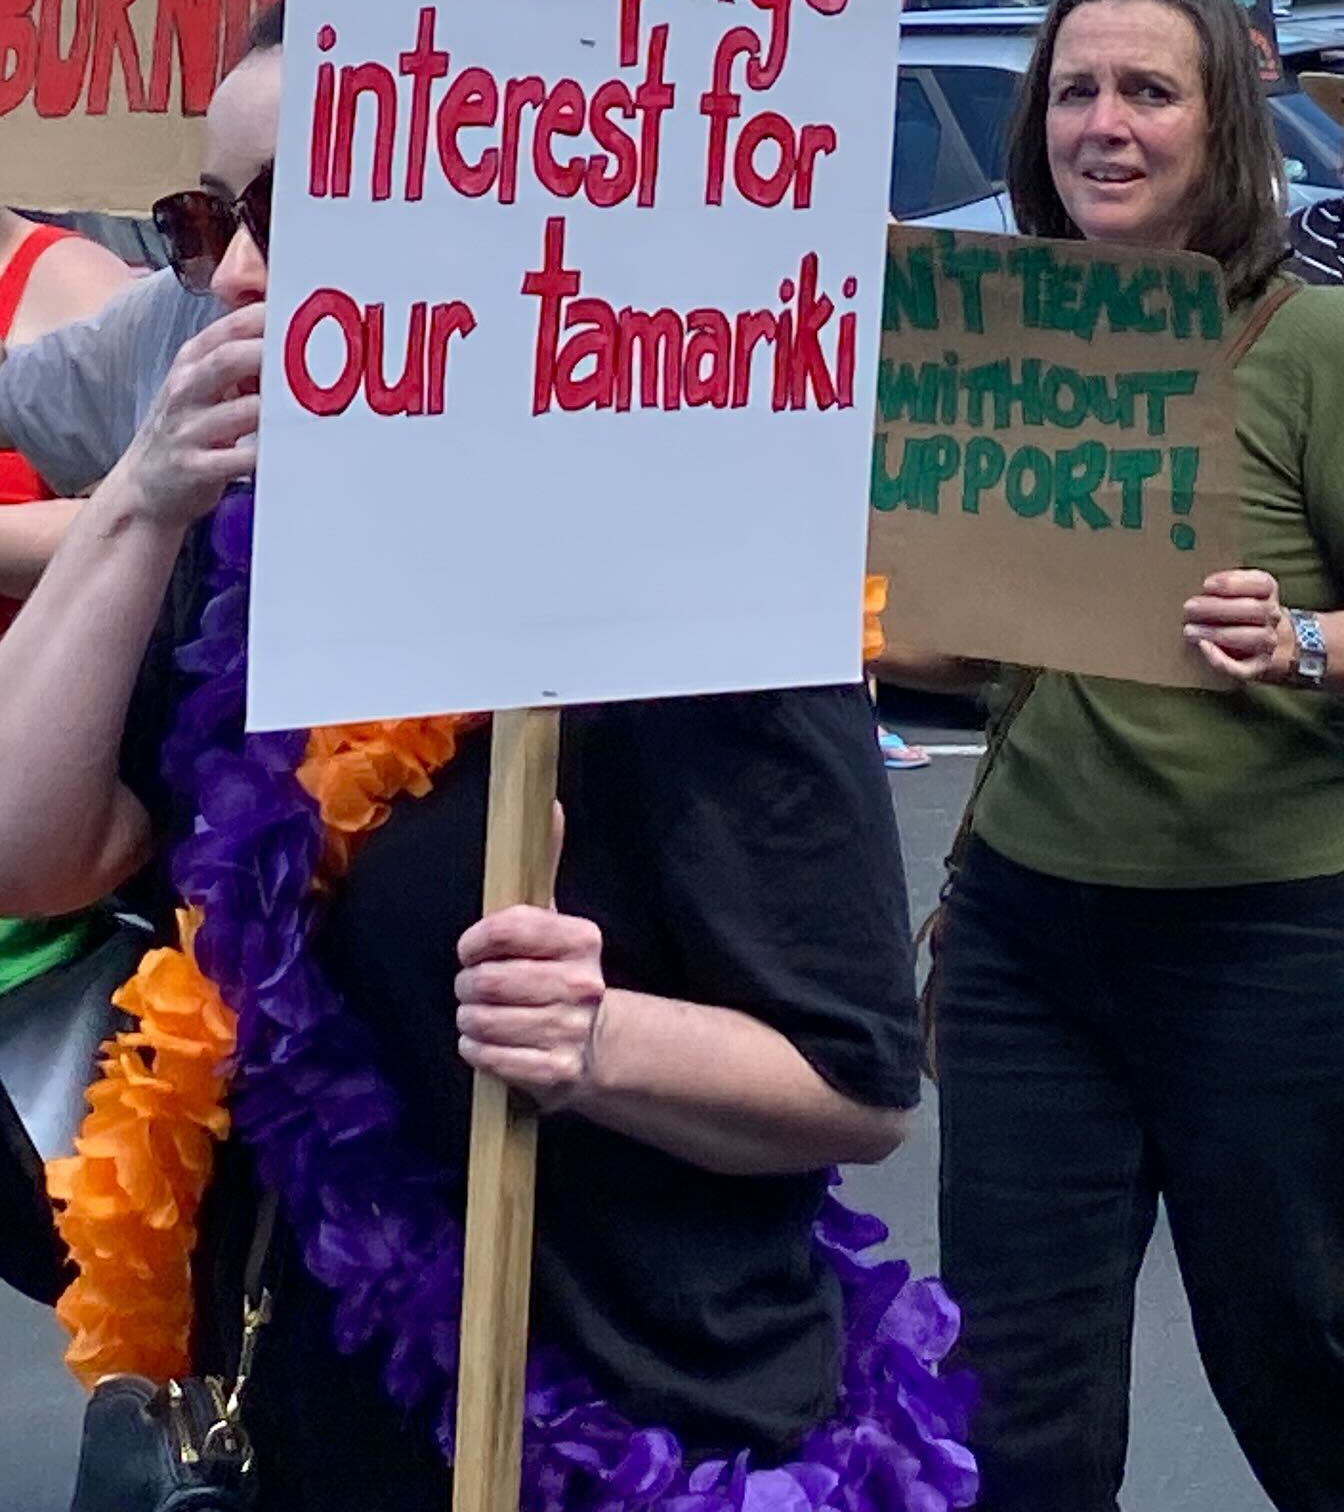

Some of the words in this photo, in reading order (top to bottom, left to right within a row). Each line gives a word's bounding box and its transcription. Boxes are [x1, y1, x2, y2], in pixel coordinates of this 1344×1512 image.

[308, 7, 675, 209] interest
[700, 25, 837, 209] for
[284, 287, 476, 417] our
[1008, 247, 1223, 342] TEACH
